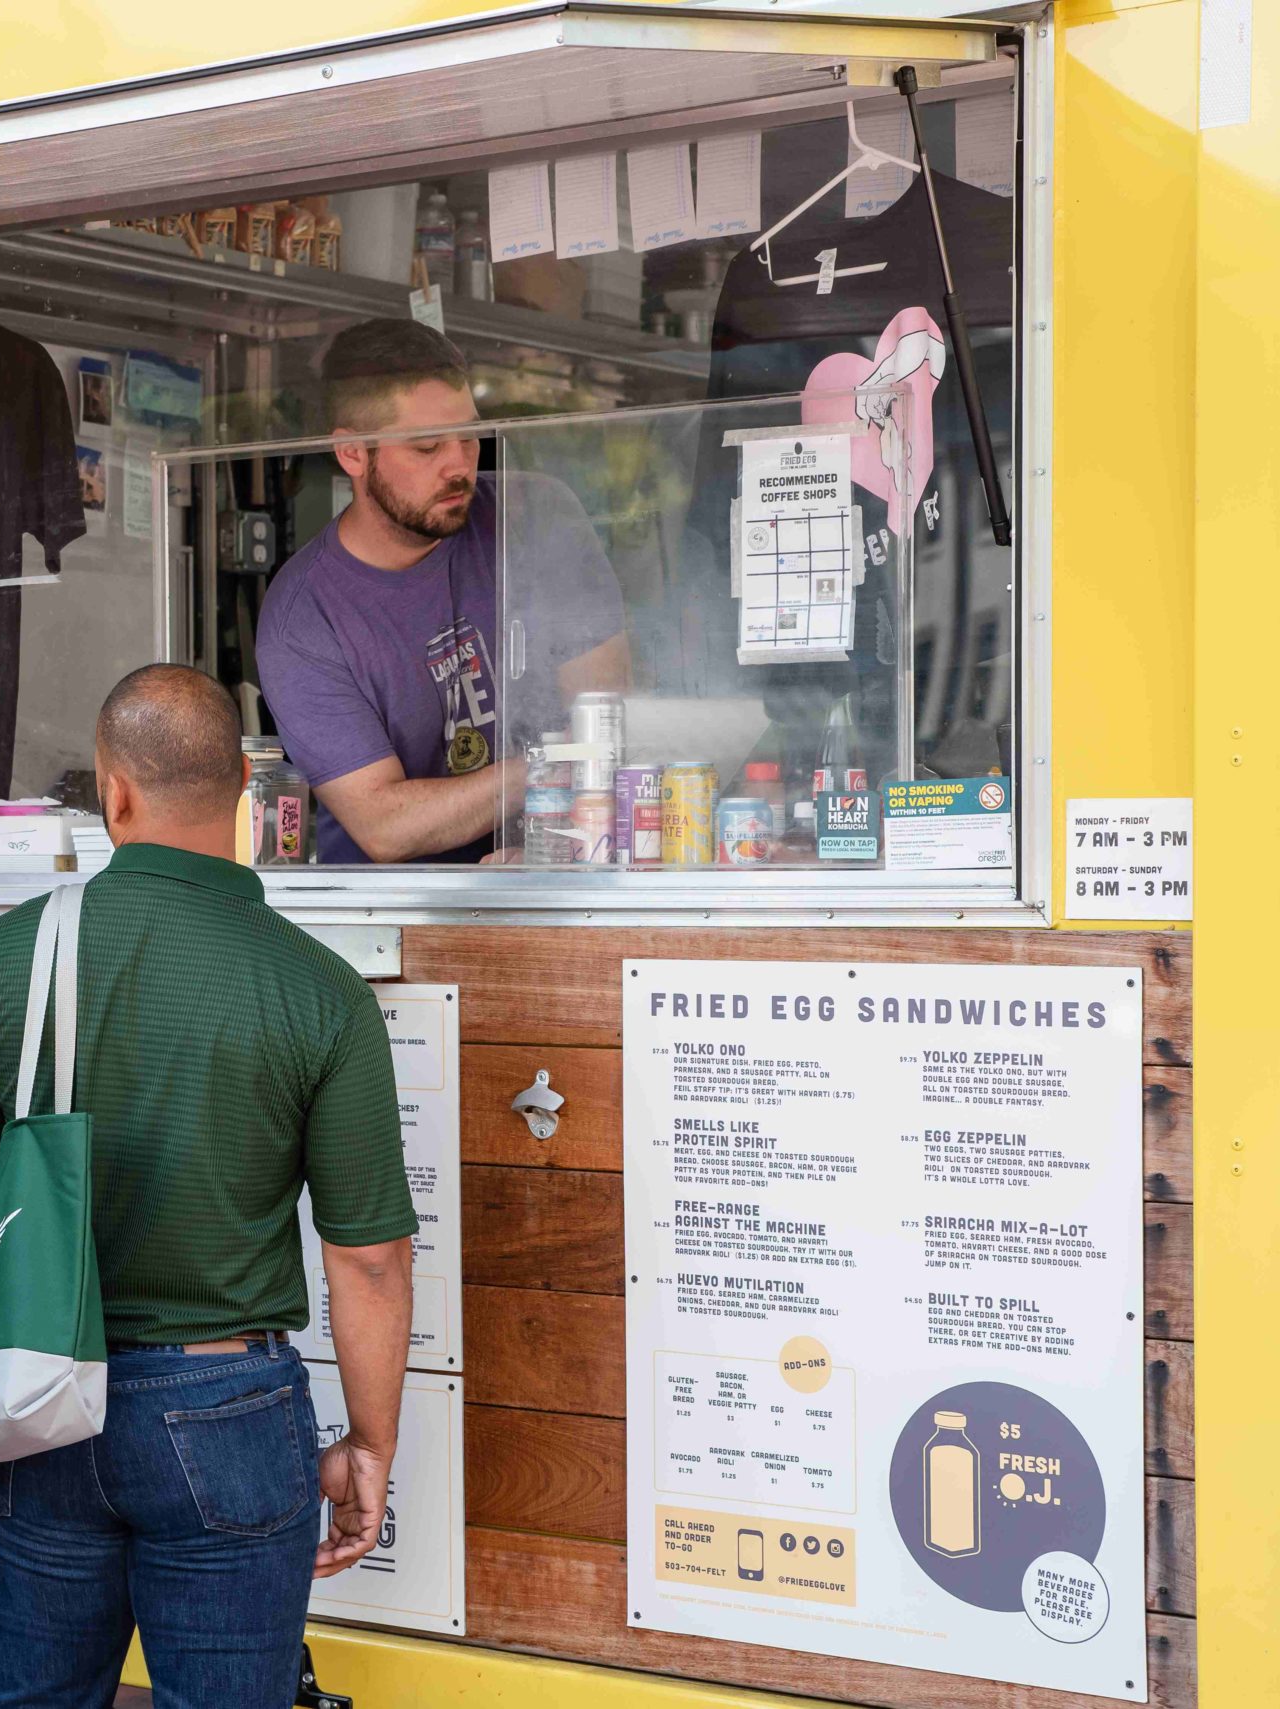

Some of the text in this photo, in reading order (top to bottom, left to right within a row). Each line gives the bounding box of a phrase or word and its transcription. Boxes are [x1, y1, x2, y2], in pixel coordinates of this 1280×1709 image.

[780, 455, 816, 465] FRIED EGG
[760, 474, 837, 488] RECOMMENDED
[761, 489, 836, 502] COFFEE SHOPS
[889, 784, 964, 796] NO SMOKING
[889, 796, 953, 808] OR VAPING
[829, 812, 868, 823] HEART
[1076, 833, 1086, 847] 7
[1093, 832, 1118, 847] AM
[1143, 831, 1154, 847] 3
[1161, 831, 1187, 846] PM
[1076, 881, 1087, 896] 8
[1093, 881, 1119, 896] AM
[1144, 881, 1155, 896] 3
[1162, 881, 1188, 896] PM
[651, 992, 1107, 1029] FRIED EGG SANDWICHES
[673, 1042, 746, 1056] YOLKO ONO
[922, 1050, 1043, 1066] YOLKO ZEPPELIN
[978, 1067, 1003, 1075] YOLKO
[1046, 1069, 1067, 1077] WITH
[922, 1075, 952, 1083] DOUBLE
[992, 1077, 1023, 1086] DOUBLE
[674, 1118, 759, 1133] SMELLS LIKE
[674, 1133, 777, 1149] PROTEIN SPIRIT
[924, 1129, 1026, 1146] EGG ZEPPELIN
[674, 1199, 760, 1216] FREE-RANGE
[675, 1214, 826, 1236] AGAINST THE MACHINE
[924, 1215, 1088, 1237] SRIRACHA MIX-A-LOT
[677, 1272, 804, 1294] HUEVO MUTILATION
[928, 1292, 1040, 1313] BUILT TO SPILL
[784, 1359, 826, 1370] ADD-ONS
[707, 1398, 757, 1410] VEGGIE PATTY
[770, 1405, 784, 1414] EGG
[805, 1409, 833, 1418] CHEESE
[999, 1421, 1021, 1439] $5
[670, 1452, 701, 1462] AVOCADO
[999, 1453, 1060, 1475] FRESH
[802, 1466, 833, 1477] TOMATO
[664, 1518, 715, 1533] CALL AHEAD
[664, 1530, 712, 1543] AND ORDER
[664, 1541, 693, 1552] TO-GO
[665, 1561, 726, 1576] 503-704-FELT
[778, 1575, 846, 1592] @FRIEDEGGLOVE
[1038, 1569, 1096, 1591] MANY MORE
[1038, 1579, 1093, 1600] BEVERAGES
[1040, 1589, 1057, 1600] FOR
[1035, 1598, 1092, 1620] PLEASE SEE
[1041, 1609, 1083, 1627] DISPLAY.
